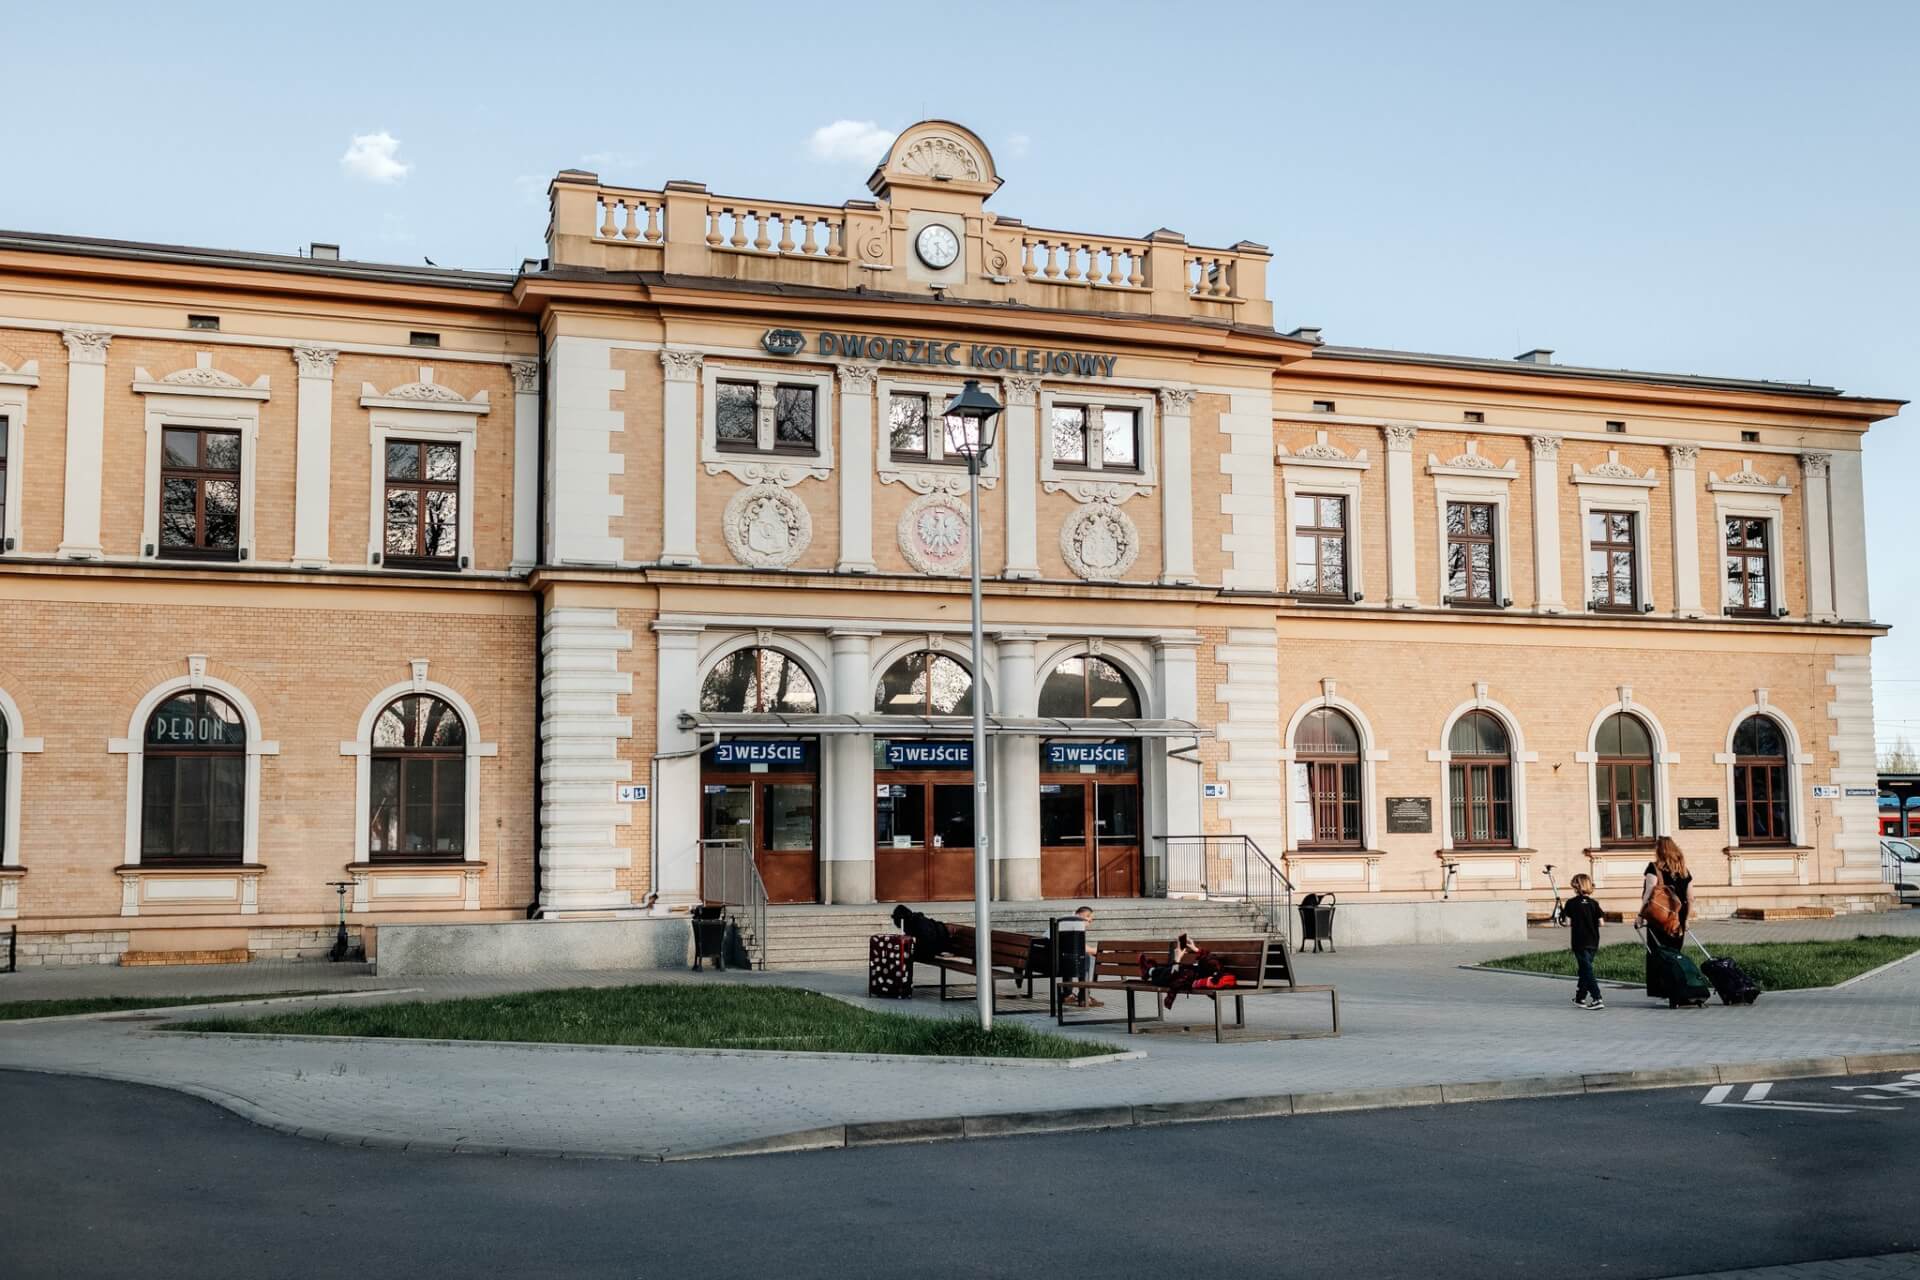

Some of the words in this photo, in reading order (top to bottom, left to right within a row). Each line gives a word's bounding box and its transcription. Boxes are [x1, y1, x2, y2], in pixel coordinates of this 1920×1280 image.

[768, 334, 801, 348] PKP
[818, 332, 962, 366] DWORZEC
[971, 344, 1118, 377] KOLEJOWY
[157, 717, 223, 740] PERON
[736, 743, 801, 760] WEJŚCIE
[906, 744, 969, 761] WEJŚCIE
[1067, 745, 1125, 761] WEJŚCIE
